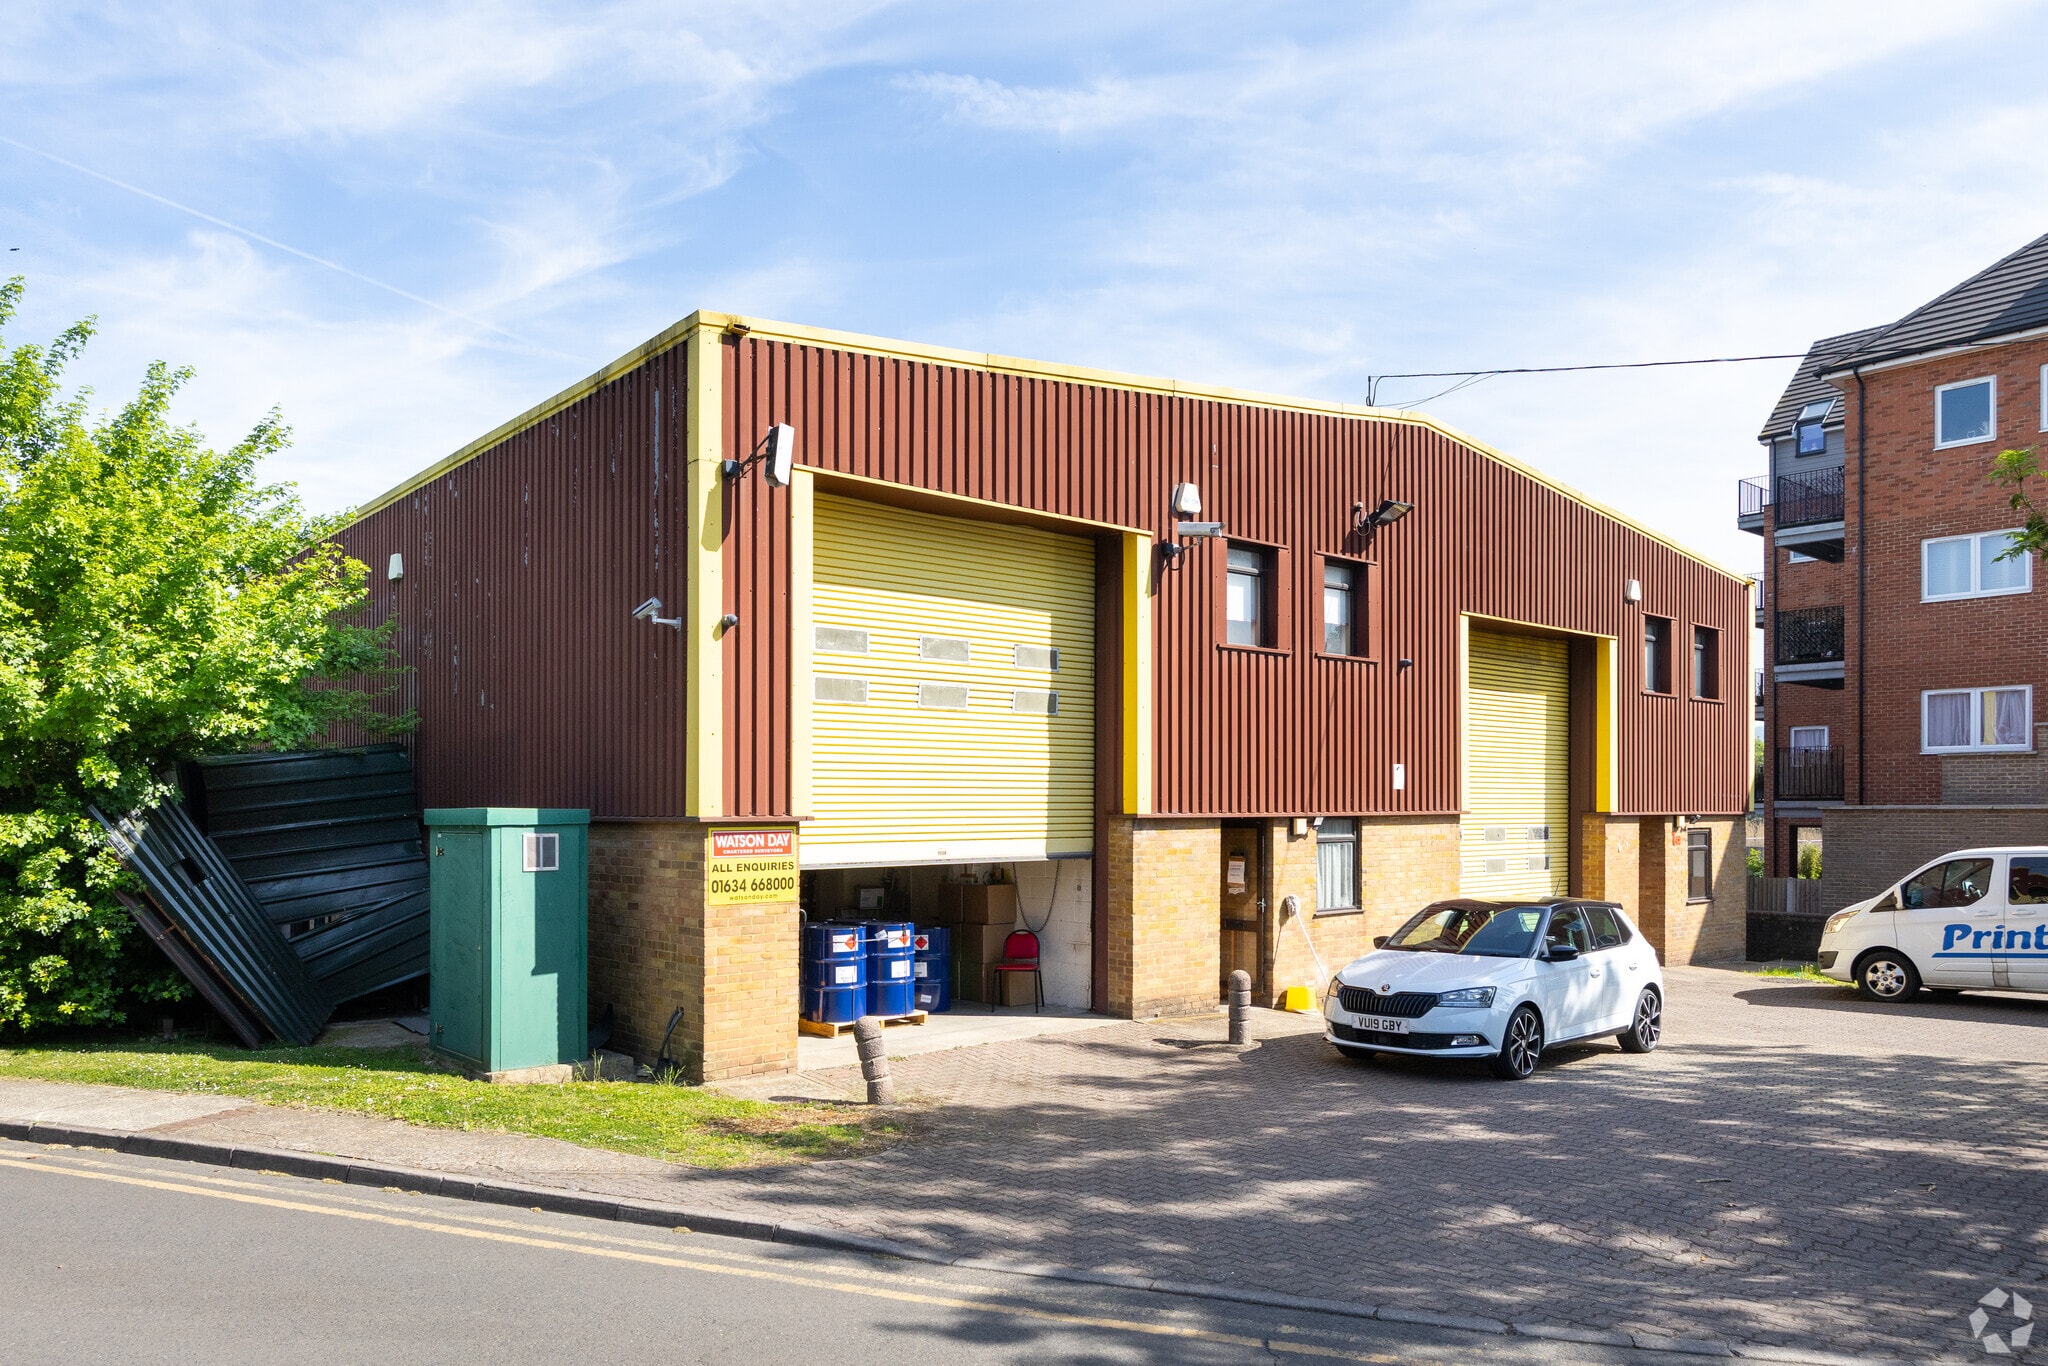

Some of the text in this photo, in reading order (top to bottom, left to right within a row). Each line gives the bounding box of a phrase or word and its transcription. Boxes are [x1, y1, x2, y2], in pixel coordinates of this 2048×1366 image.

[715, 833, 790, 848] WATSON DAY
[711, 862, 795, 873] ALL ENQUIRIES
[711, 877, 794, 893] 01634 668000
[729, 893, 778, 901] watsonday.com
[1358, 1017, 1402, 1031] VU19 GBY
